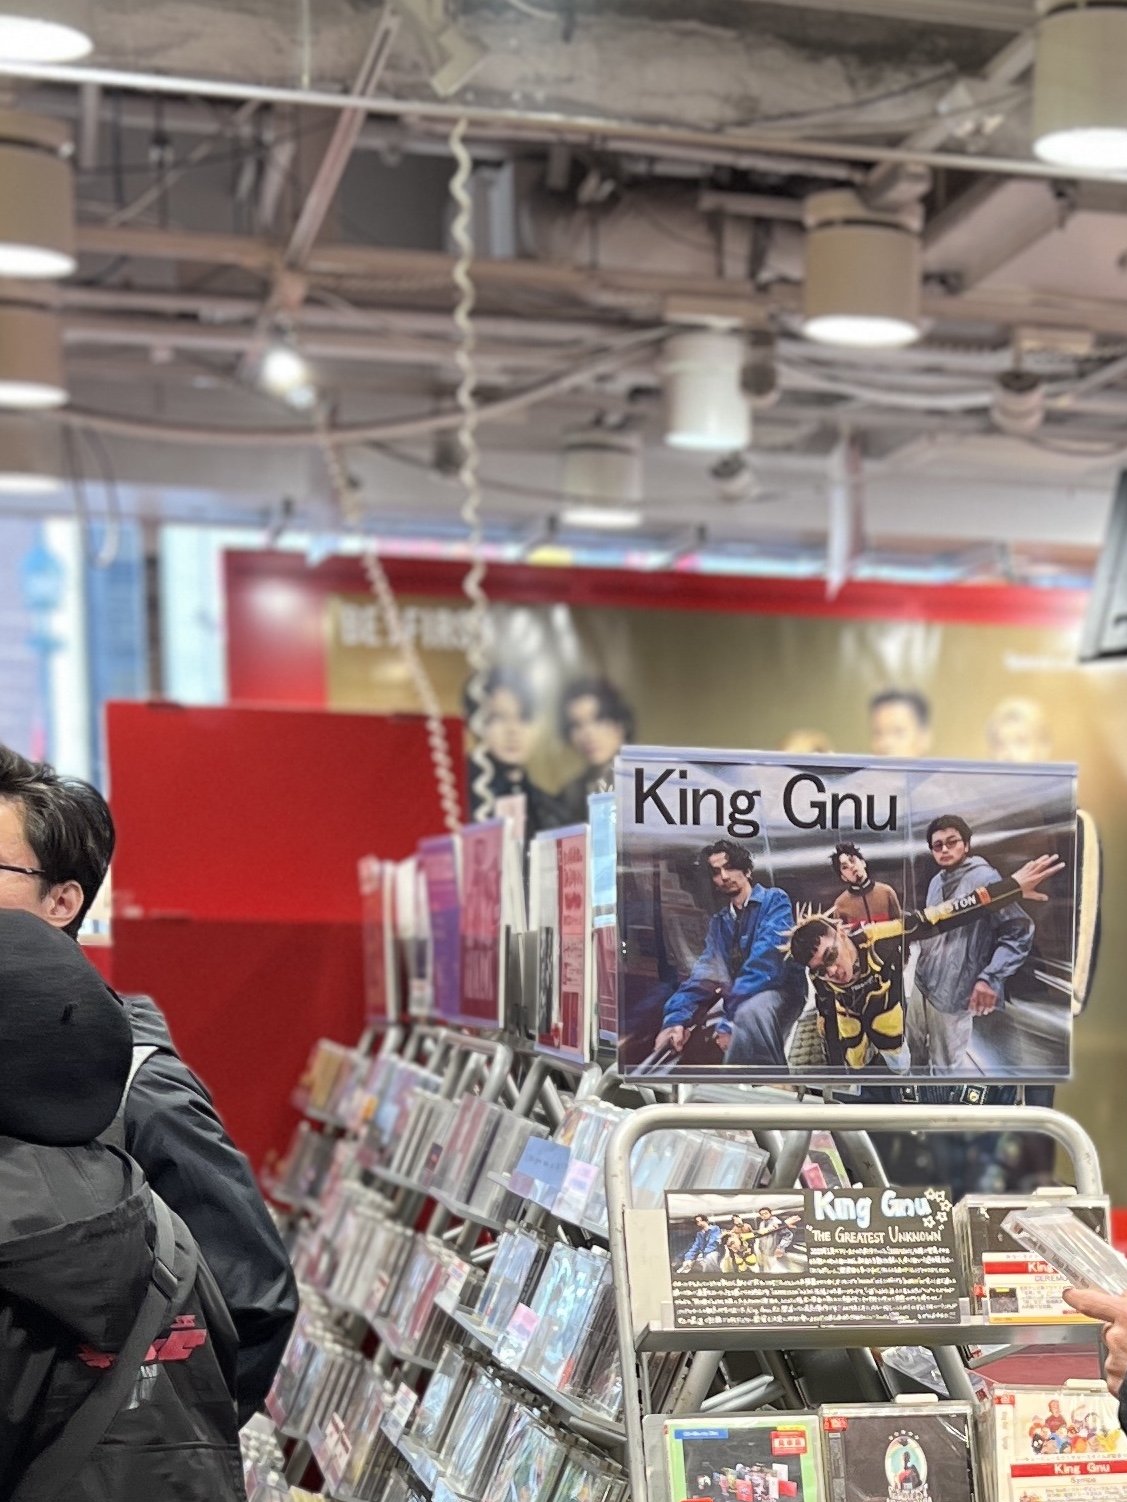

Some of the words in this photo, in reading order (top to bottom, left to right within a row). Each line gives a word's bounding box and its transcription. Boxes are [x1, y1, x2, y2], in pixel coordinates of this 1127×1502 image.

[633, 766, 762, 838] King
[782, 773, 898, 831] Gnu
[813, 1190, 872, 1229] King
[881, 1189, 933, 1218] Gnu
[1054, 1463, 1081, 1475] King
[1086, 1462, 1110, 1473] Gnu
